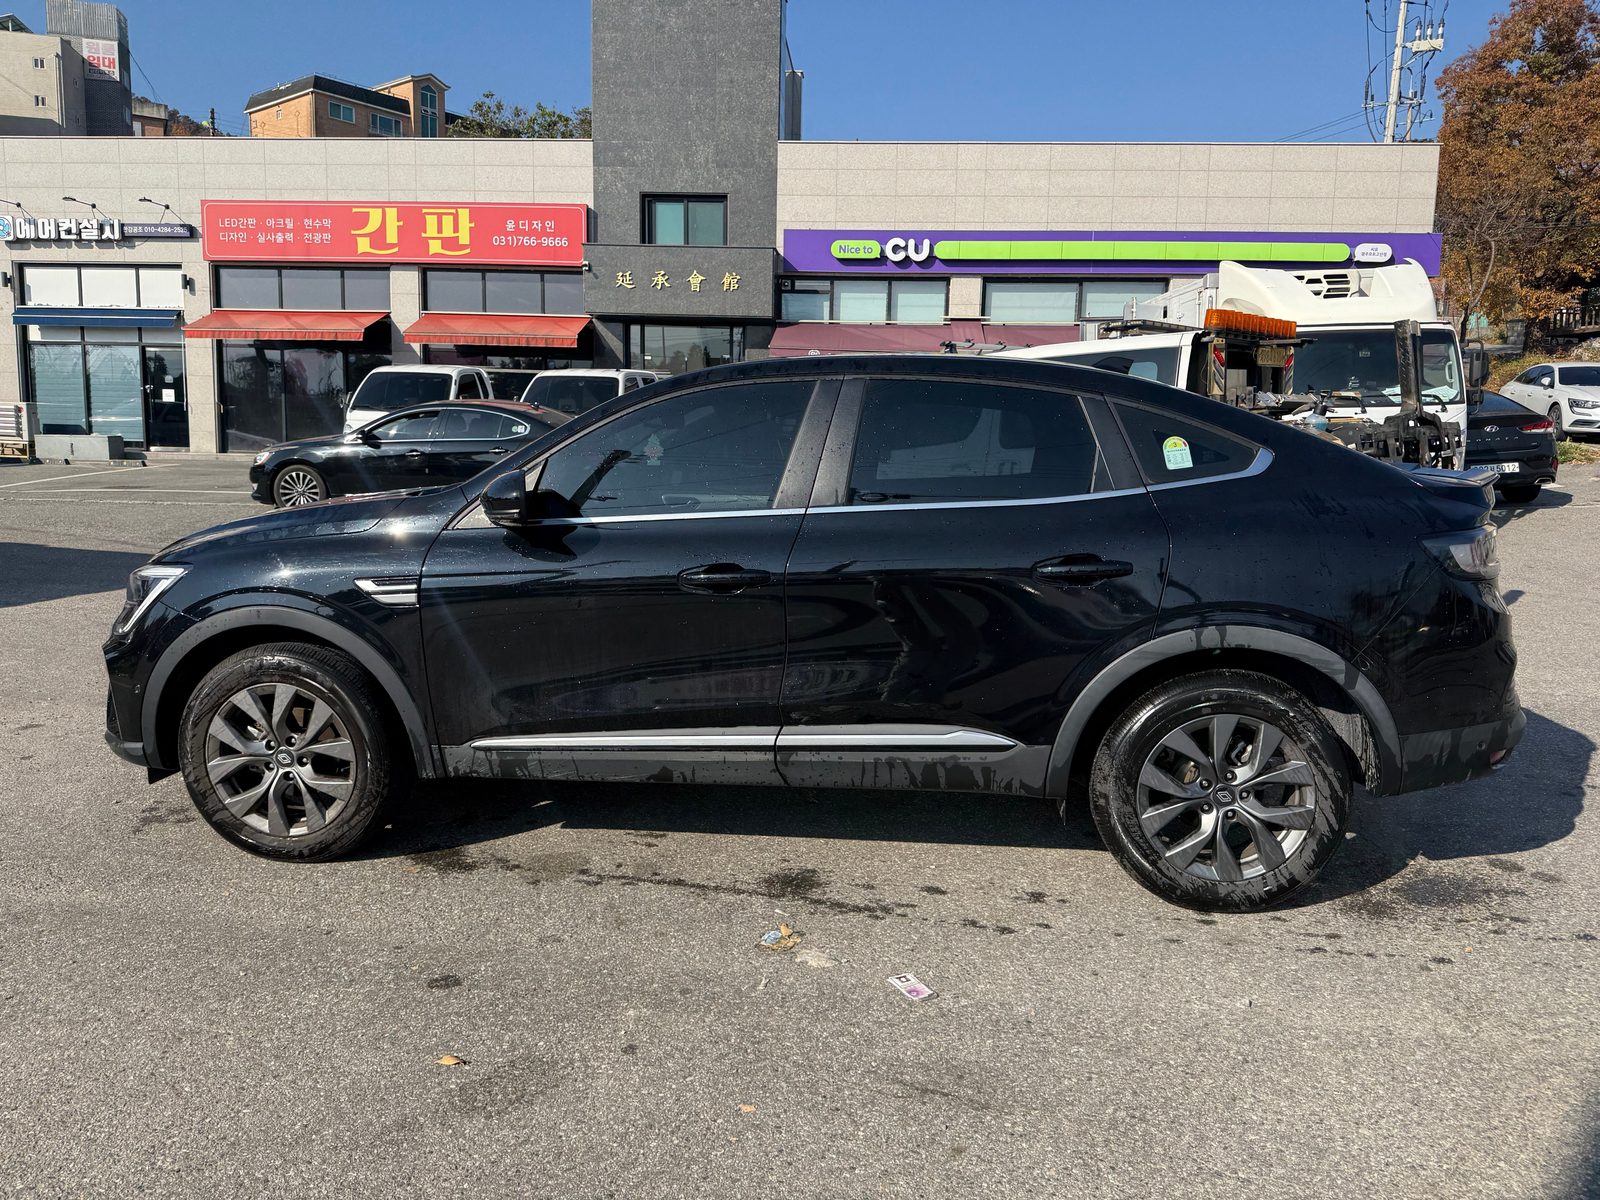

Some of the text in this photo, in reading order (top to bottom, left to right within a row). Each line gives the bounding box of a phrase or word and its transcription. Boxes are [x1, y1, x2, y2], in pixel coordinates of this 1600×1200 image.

[87, 55, 116, 69] 임대
[15, 218, 120, 241] 에어컨설치
[219, 218, 332, 230] LED간판 아크릴 현수막
[219, 232, 332, 244] 디자인 실사출력 전광판
[492, 235, 569, 248] 031)766-9666
[838, 237, 930, 262] Nice to CU
[615, 269, 742, 292] 延承會館
